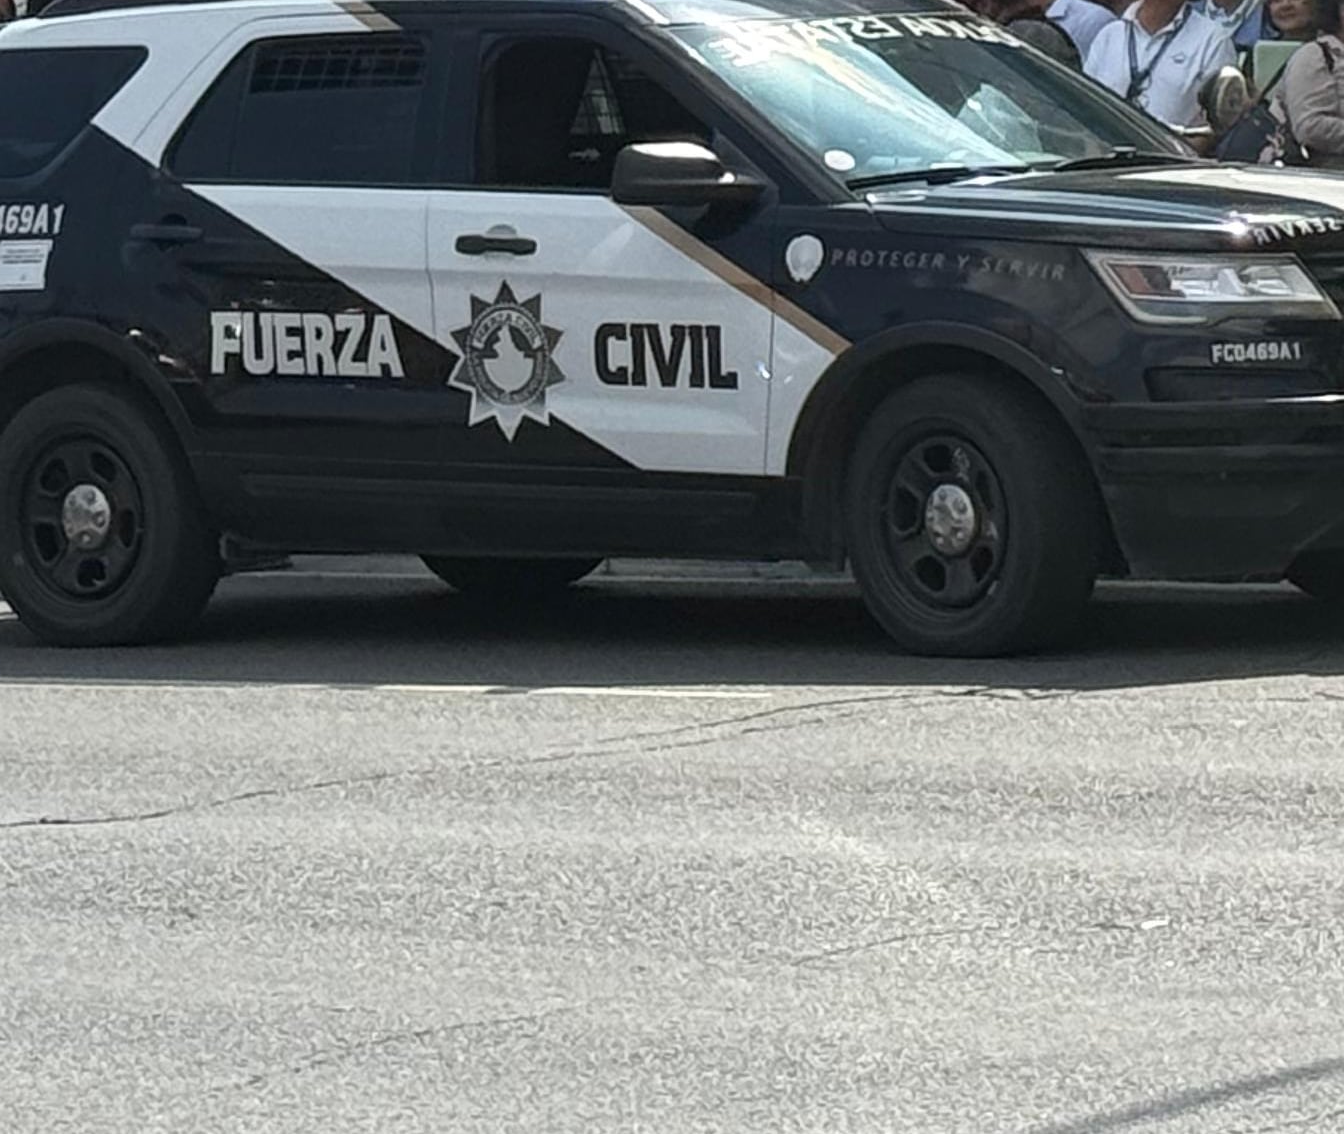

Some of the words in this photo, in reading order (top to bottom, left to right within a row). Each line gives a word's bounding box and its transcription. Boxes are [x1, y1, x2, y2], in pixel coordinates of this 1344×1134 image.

[831, 248, 946, 268] PROTEGER
[957, 254, 971, 268] Y
[982, 256, 1065, 280] SERVIR
[209, 311, 405, 379] FUERZA
[594, 323, 739, 390] CIVIL
